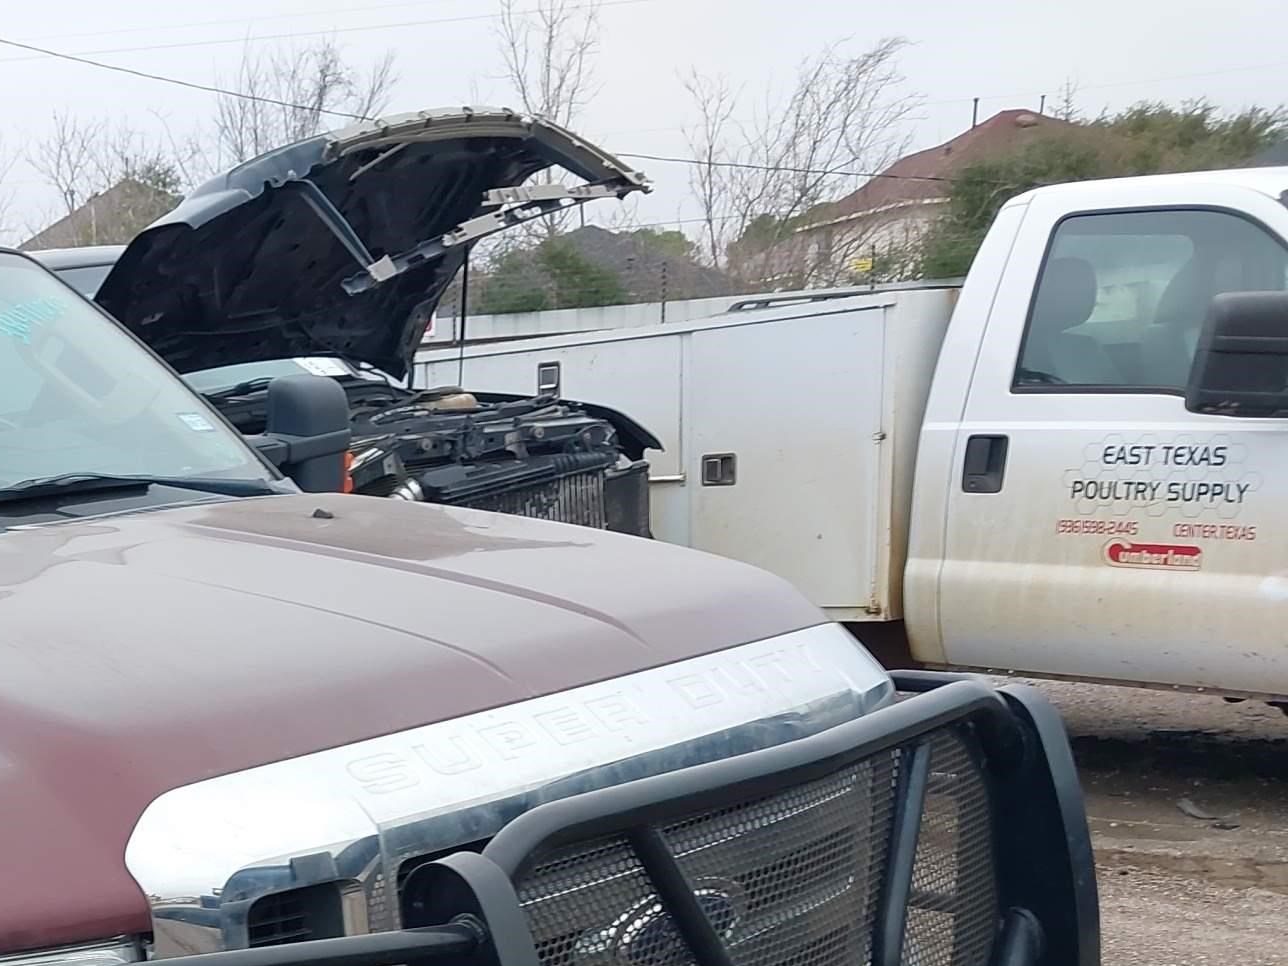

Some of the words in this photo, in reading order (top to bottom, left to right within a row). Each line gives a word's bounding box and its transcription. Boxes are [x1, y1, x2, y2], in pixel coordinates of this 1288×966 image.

[1102, 445, 1155, 466] EAST
[1163, 446, 1228, 467] TEXAS
[1070, 480, 1161, 501] POULTRY
[1166, 482, 1250, 504] SUPPLY
[345, 692, 650, 795] SUPER
[665, 643, 824, 710] DUTY
